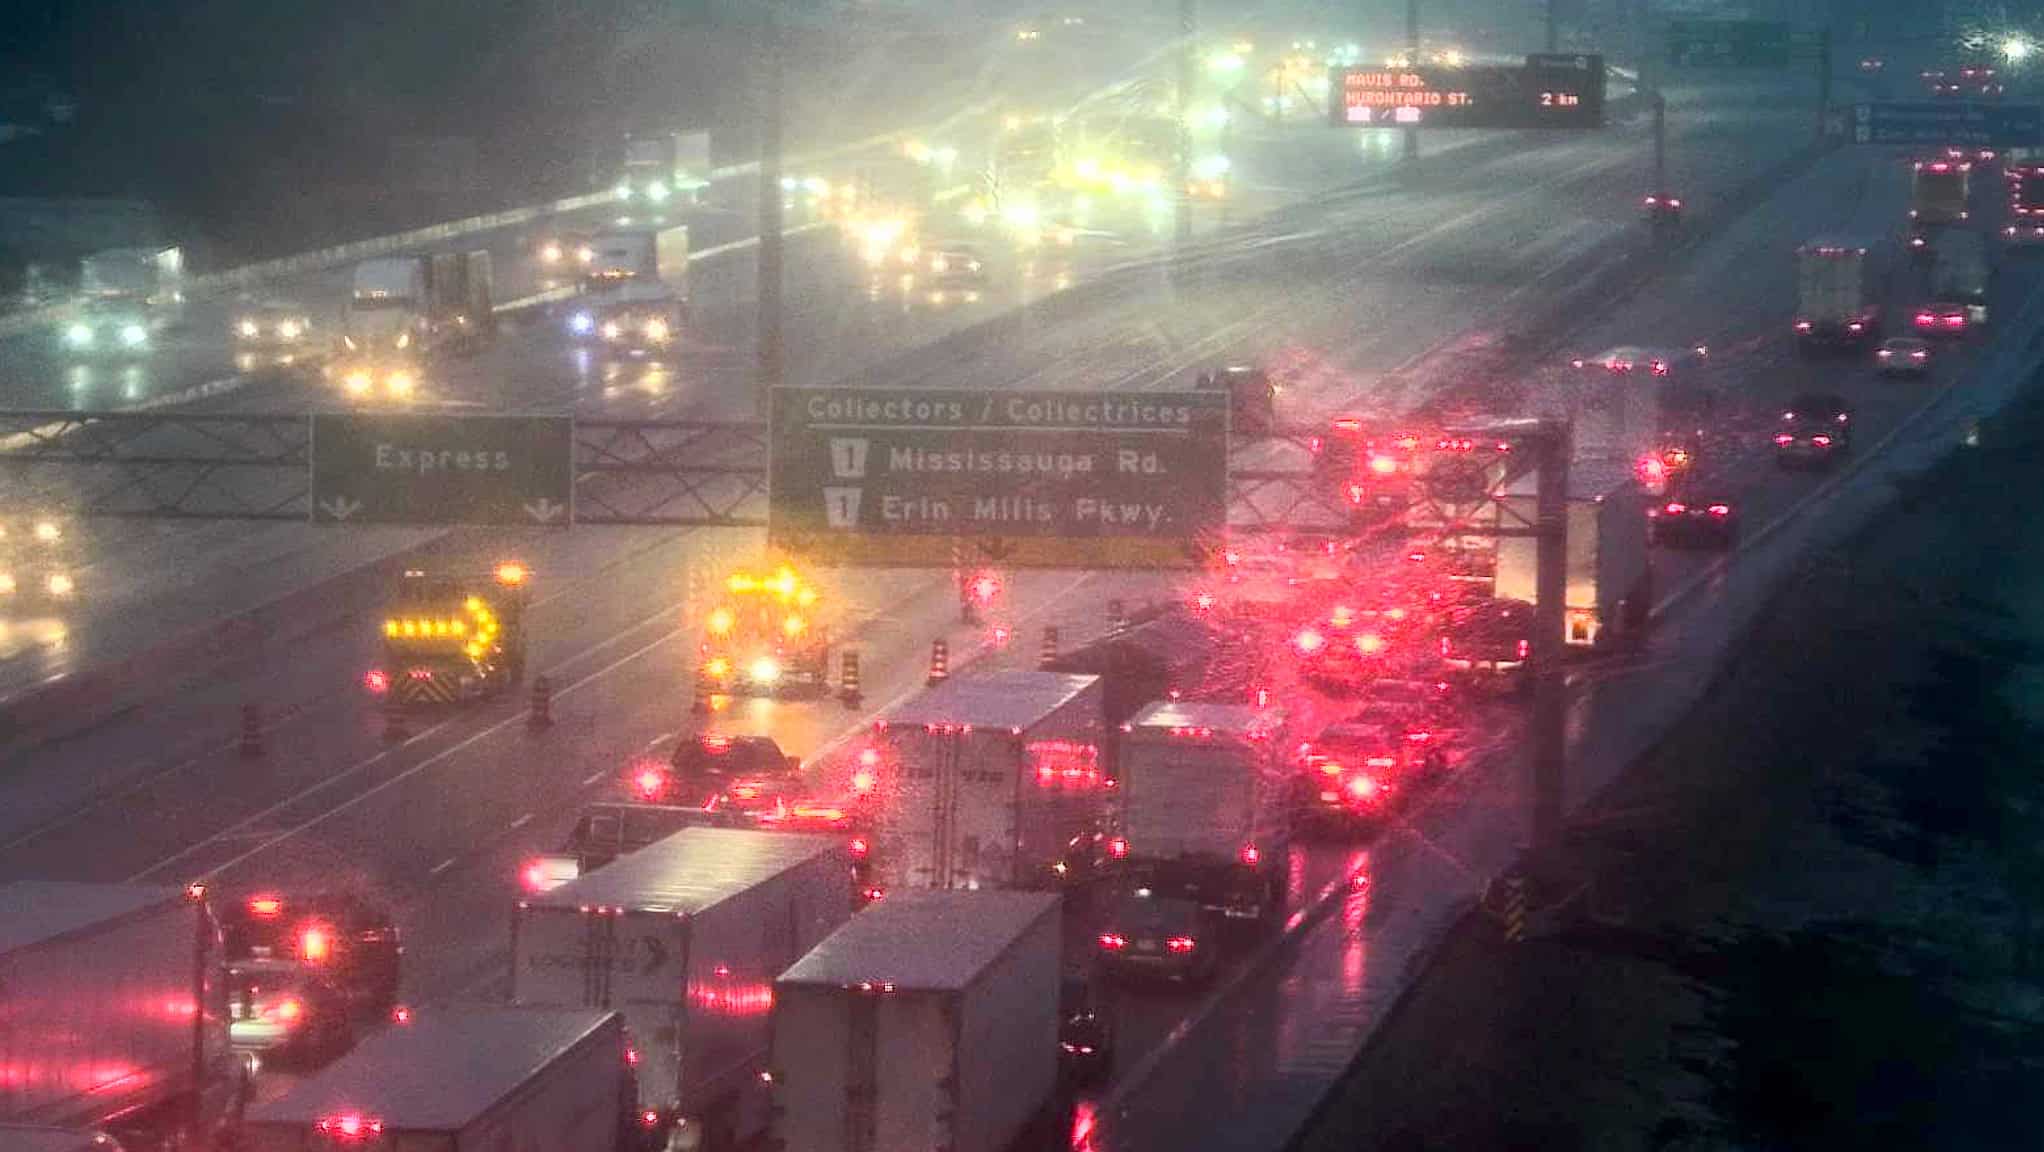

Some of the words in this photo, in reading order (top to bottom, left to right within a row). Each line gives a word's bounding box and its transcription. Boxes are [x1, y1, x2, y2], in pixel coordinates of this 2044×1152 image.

[1345, 73, 1393, 87] MAVIS
[1447, 91, 1473, 105] ST.
[1541, 92, 1552, 106] 2
[806, 395, 963, 421] Collectors
[1008, 396, 1192, 424] Collectrices
[374, 443, 511, 476] Express
[889, 447, 1093, 480] Mississauga
[1118, 449, 1168, 473] Rd.
[881, 494, 951, 521] Erin
[973, 496, 1052, 521] Mills
[1074, 497, 1174, 530] Pkwy.
